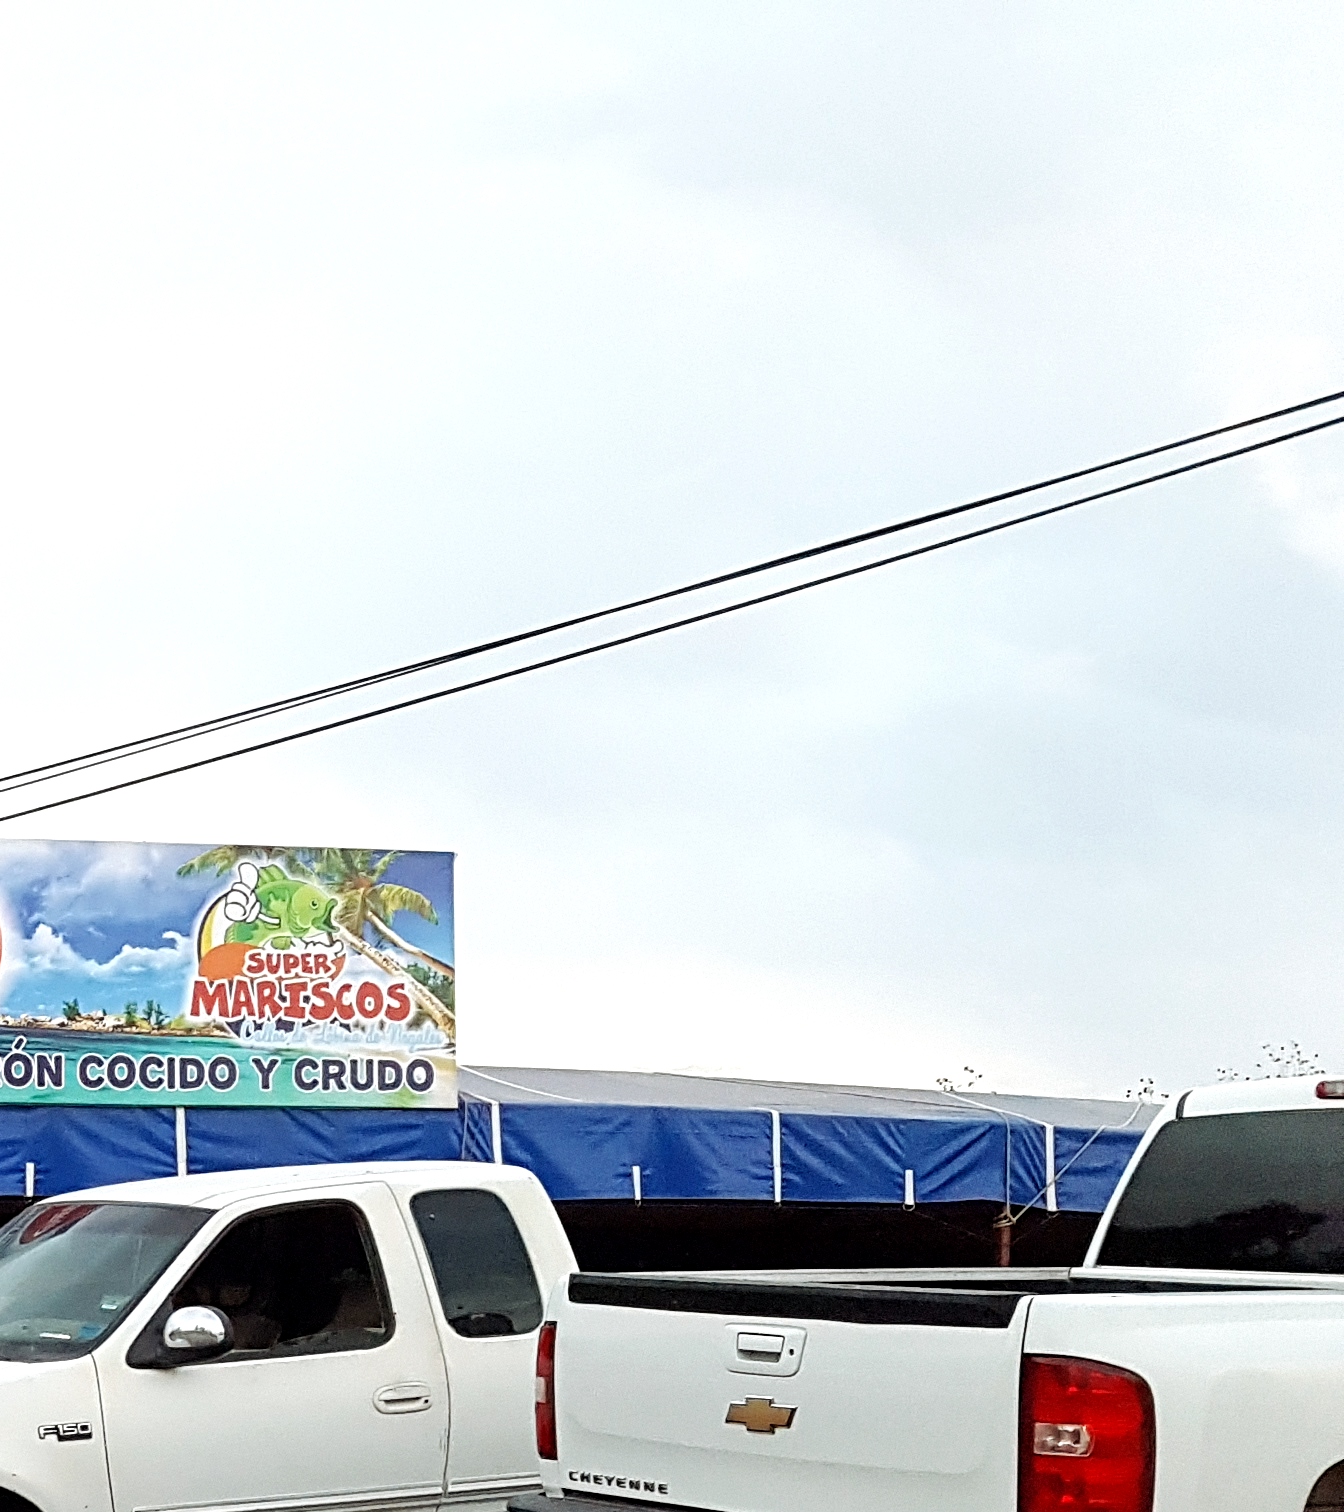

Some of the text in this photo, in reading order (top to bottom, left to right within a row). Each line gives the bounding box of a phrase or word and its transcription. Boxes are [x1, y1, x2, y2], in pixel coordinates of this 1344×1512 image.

[246, 952, 332, 975] SUPER
[189, 980, 411, 1021] MARISCOS
[78, 1053, 238, 1091] COCIDO
[252, 1057, 280, 1090] Y
[294, 1057, 434, 1092] CRUDO
[568, 1470, 669, 1494] CHEYENNE
